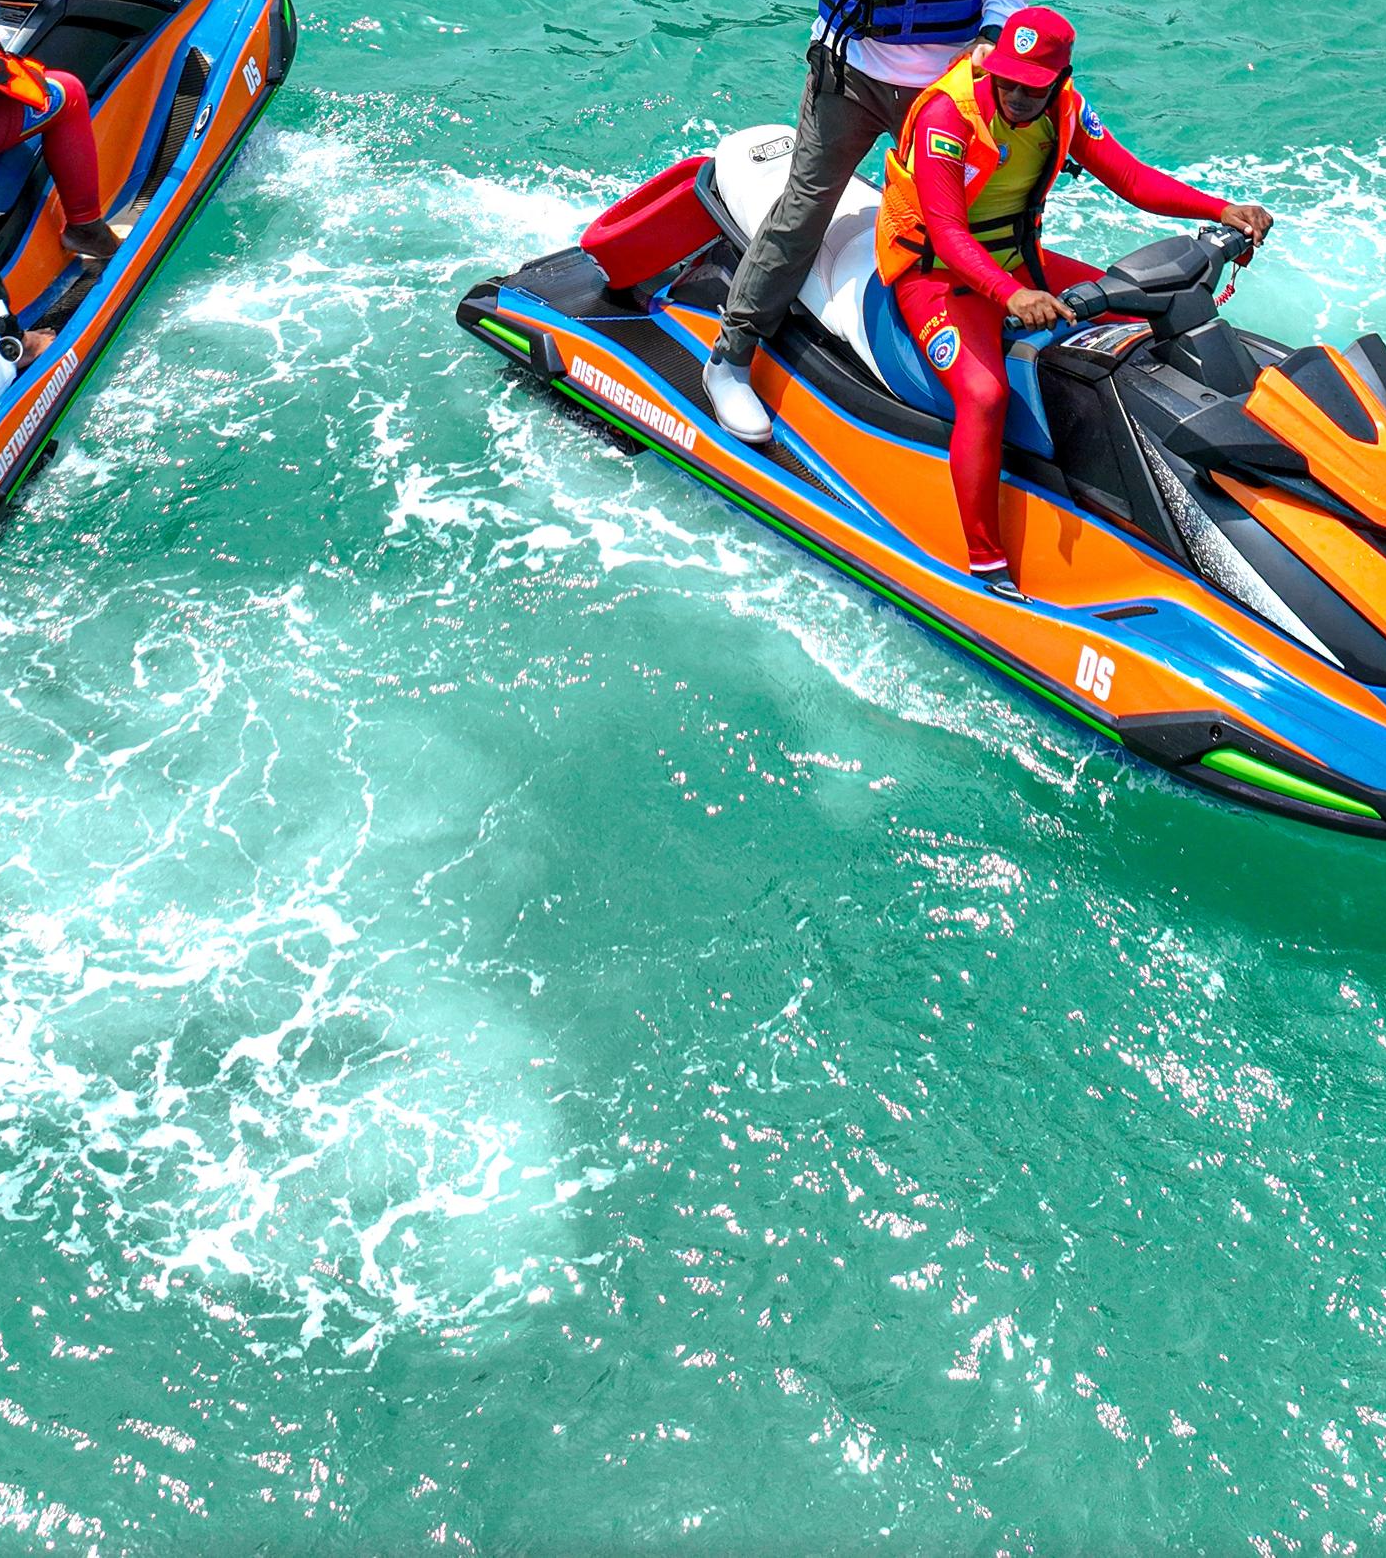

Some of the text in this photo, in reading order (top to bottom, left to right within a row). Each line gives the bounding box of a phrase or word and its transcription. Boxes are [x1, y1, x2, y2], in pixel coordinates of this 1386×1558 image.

[242, 55, 263, 97] DS
[570, 354, 697, 451] DISTRISEGURIDAD
[1074, 644, 1116, 702] DS
